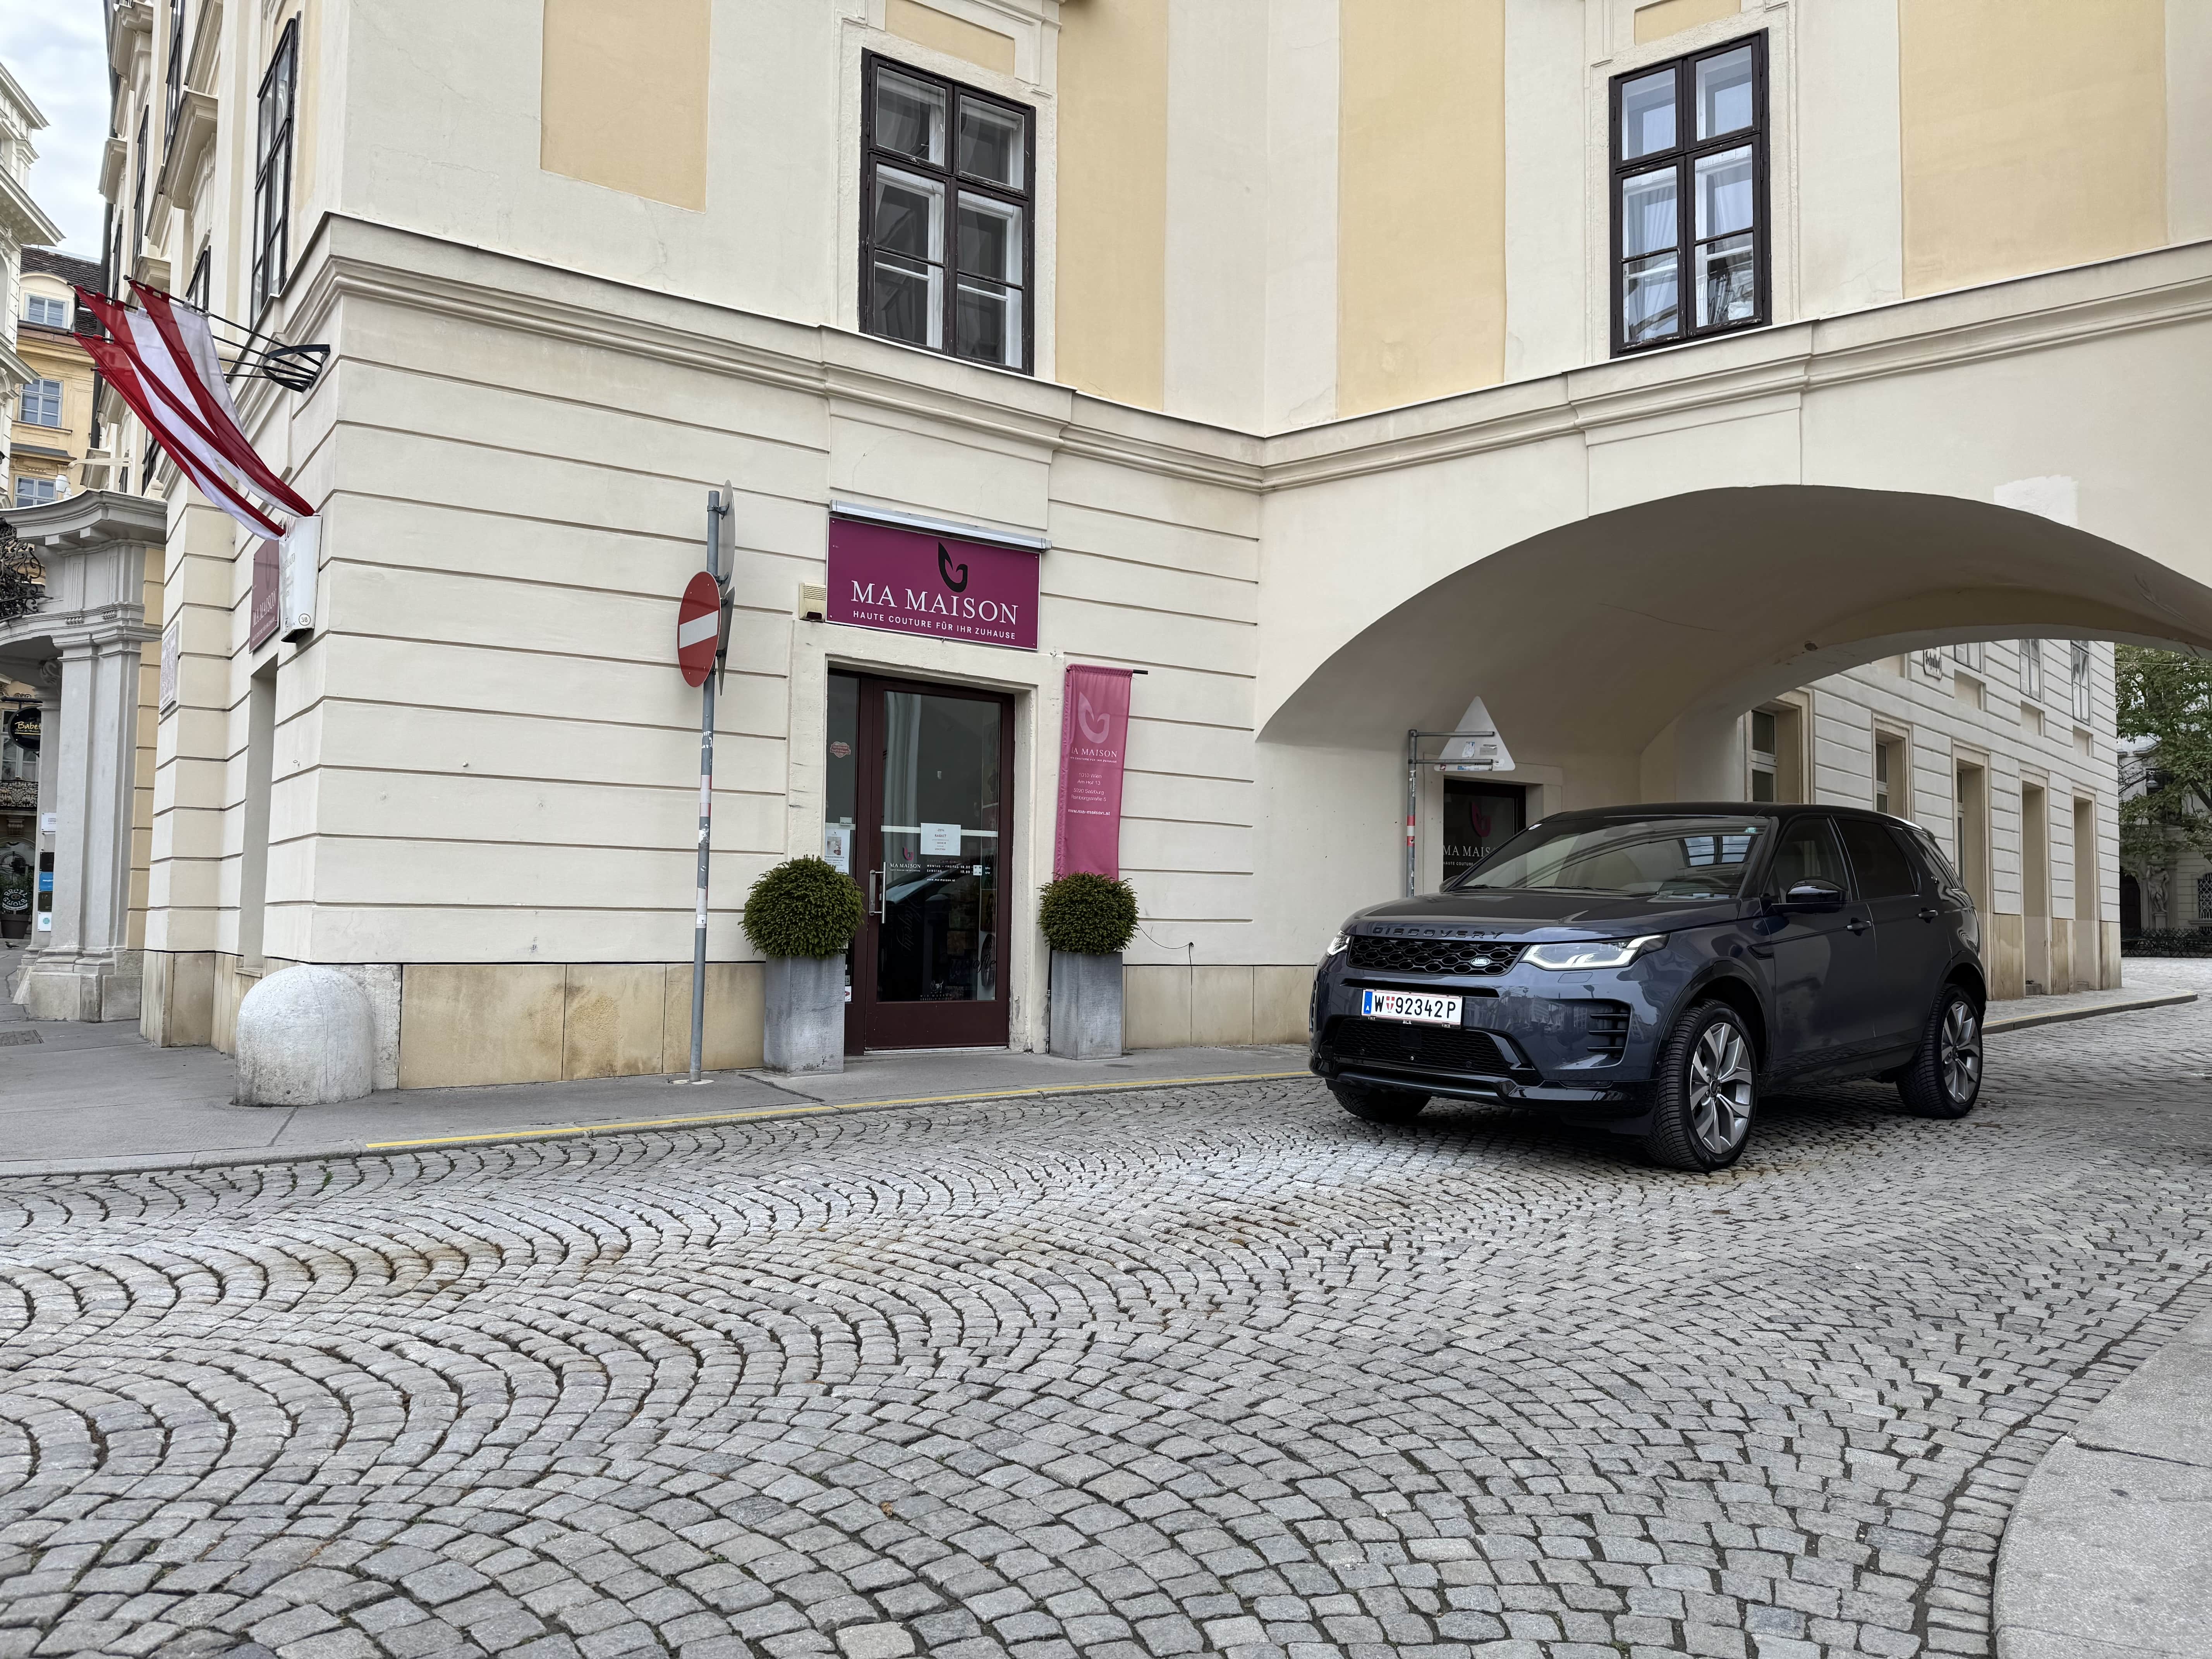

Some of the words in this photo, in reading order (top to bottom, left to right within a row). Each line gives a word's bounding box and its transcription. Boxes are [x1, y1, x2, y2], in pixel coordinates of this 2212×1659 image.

[252, 604, 259, 628] MA
[259, 588, 277, 621] MAISON
[851, 580, 897, 607] MA
[905, 588, 1018, 625] MAISON
[853, 610, 884, 622] HAUTE
[888, 615, 931, 628] COUTURE
[936, 622, 953, 631] FÜR
[957, 625, 972, 634] IHR
[975, 627, 1015, 640] ZUHAUSE
[1081, 748, 1117, 757] MAISON
[1443, 845, 1460, 856] MA
[1372, 927, 1504, 939] DISCOVERY
[1375, 995, 1384, 1012] W
[1395, 997, 1456, 1019] 92342P
